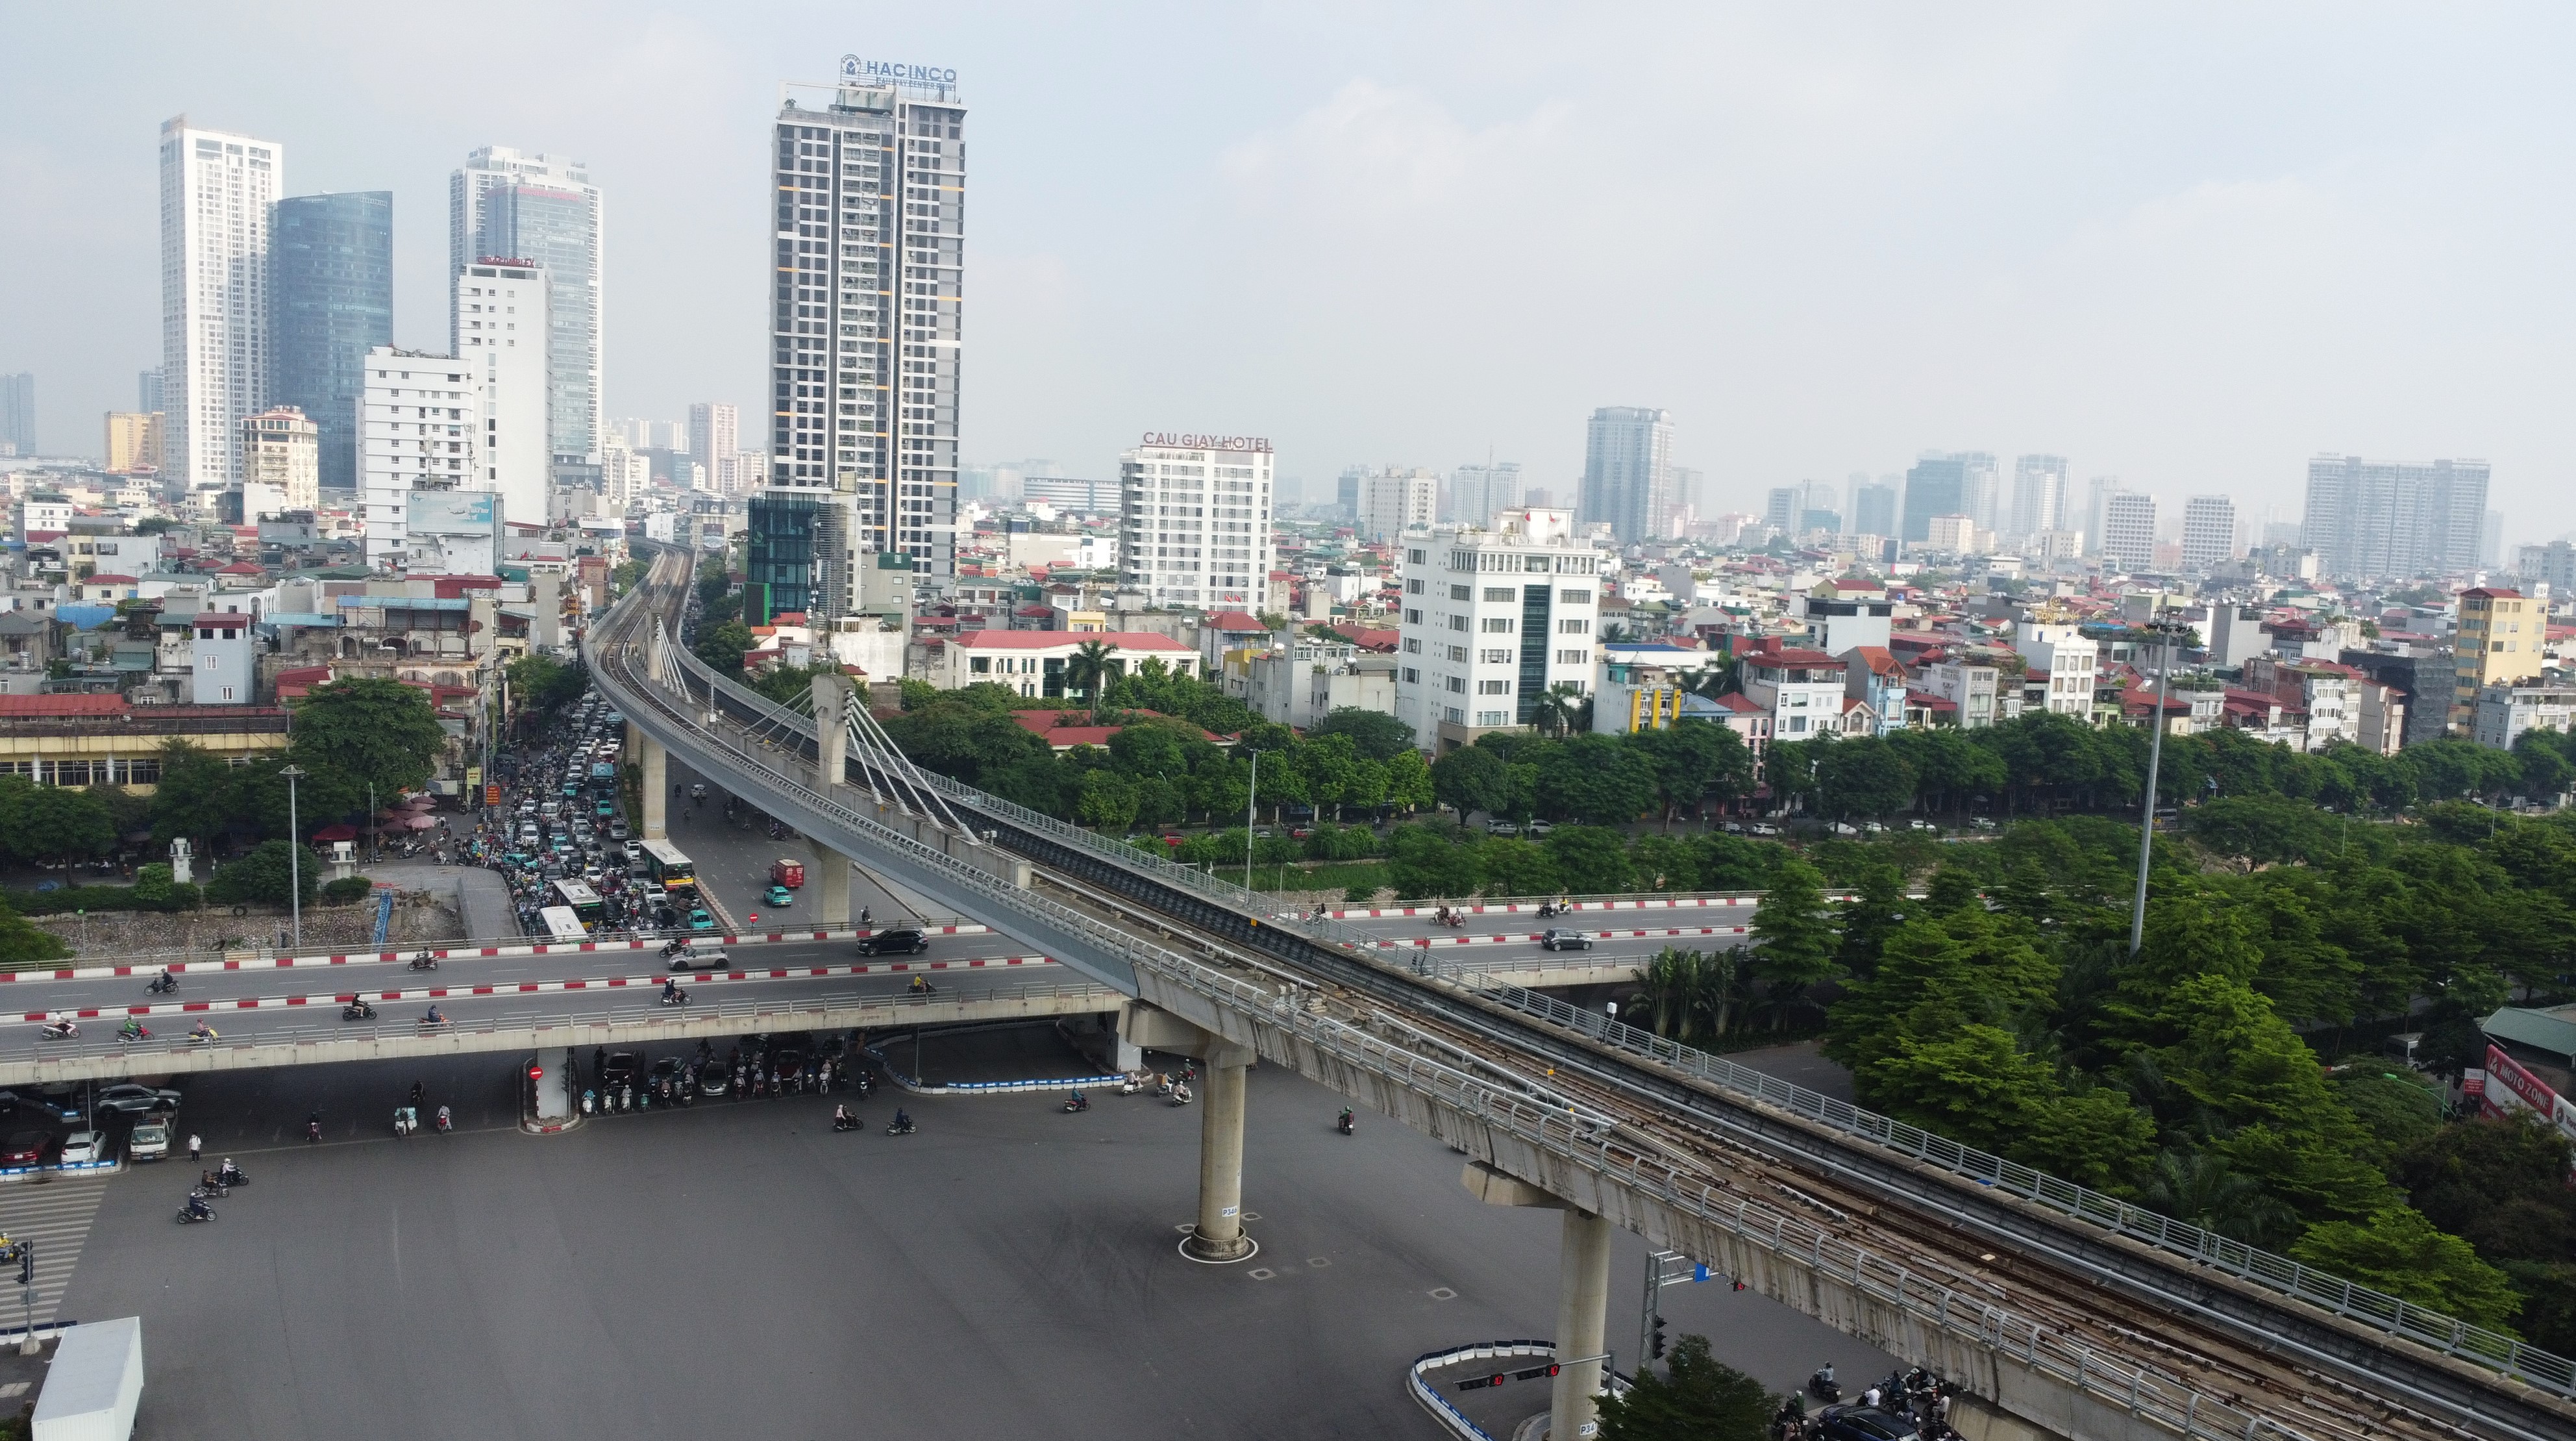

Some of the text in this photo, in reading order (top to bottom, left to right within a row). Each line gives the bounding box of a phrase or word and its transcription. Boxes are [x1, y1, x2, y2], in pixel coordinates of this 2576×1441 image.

[867, 60, 956, 82] HACINCO
[1143, 432, 1273, 451] CAU GIAY HOTEL
[2500, 1064, 2525, 1090] MOTO
[2525, 1083, 2549, 1109] ZONE
